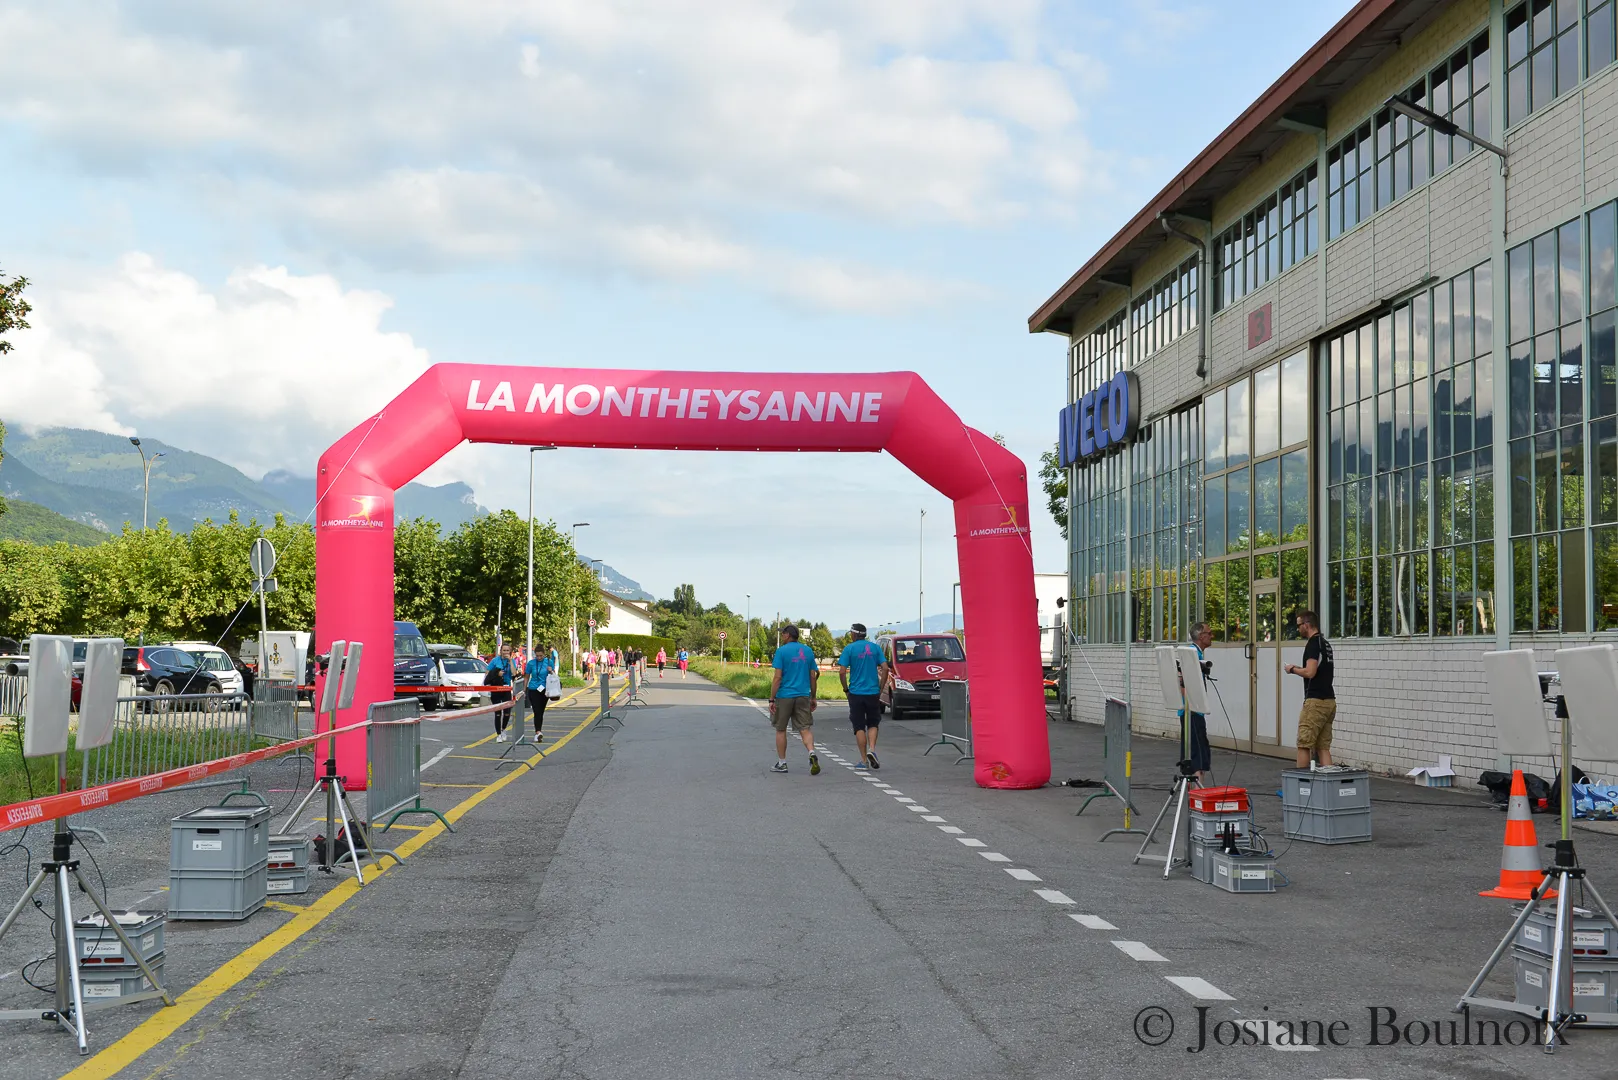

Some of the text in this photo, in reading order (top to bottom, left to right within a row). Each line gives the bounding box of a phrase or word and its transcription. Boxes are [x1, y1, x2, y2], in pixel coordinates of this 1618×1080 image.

[1253, 310, 1265, 343] 3
[466, 379, 883, 423] LA MONTHEYSANNE
[1059, 370, 1130, 469] IVECO
[328, 519, 384, 528] MONTHEYSANNE
[978, 527, 1028, 536] MONTHEYSANNE
[139, 776, 163, 793] RAIFFEISEN
[80, 788, 109, 807] RAIFFEISEN
[6, 803, 43, 824] RAIFFEISEN
